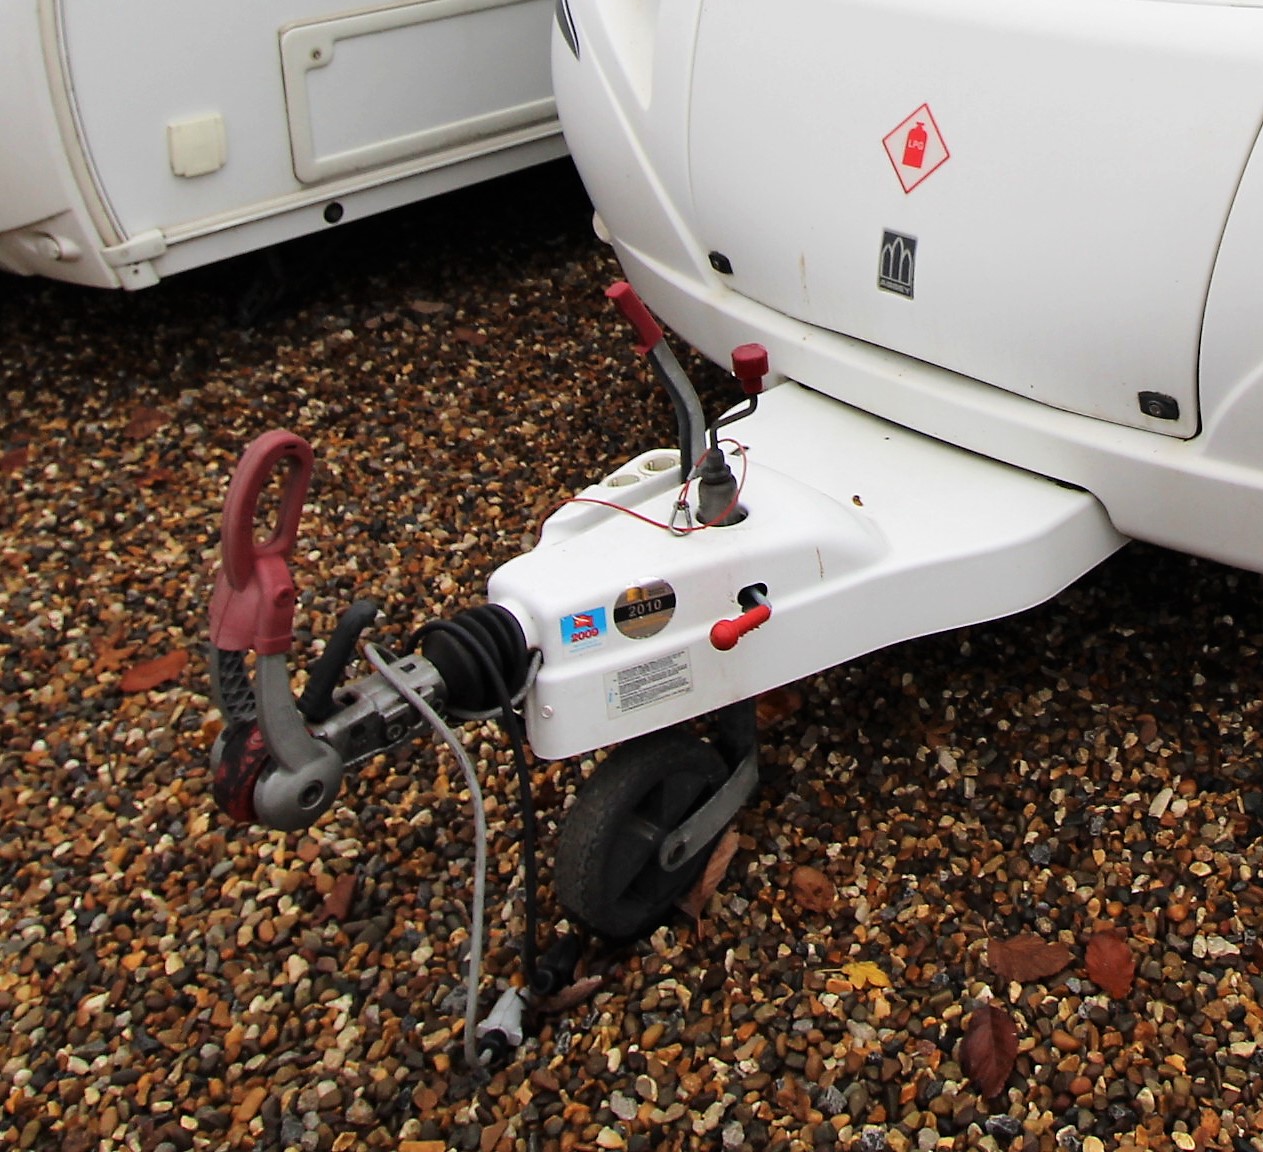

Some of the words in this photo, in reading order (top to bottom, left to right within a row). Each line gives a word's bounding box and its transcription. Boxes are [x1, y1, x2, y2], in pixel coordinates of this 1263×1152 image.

[908, 138, 924, 151] LPG
[629, 599, 662, 617] 2010
[571, 628, 599, 643] 2009
